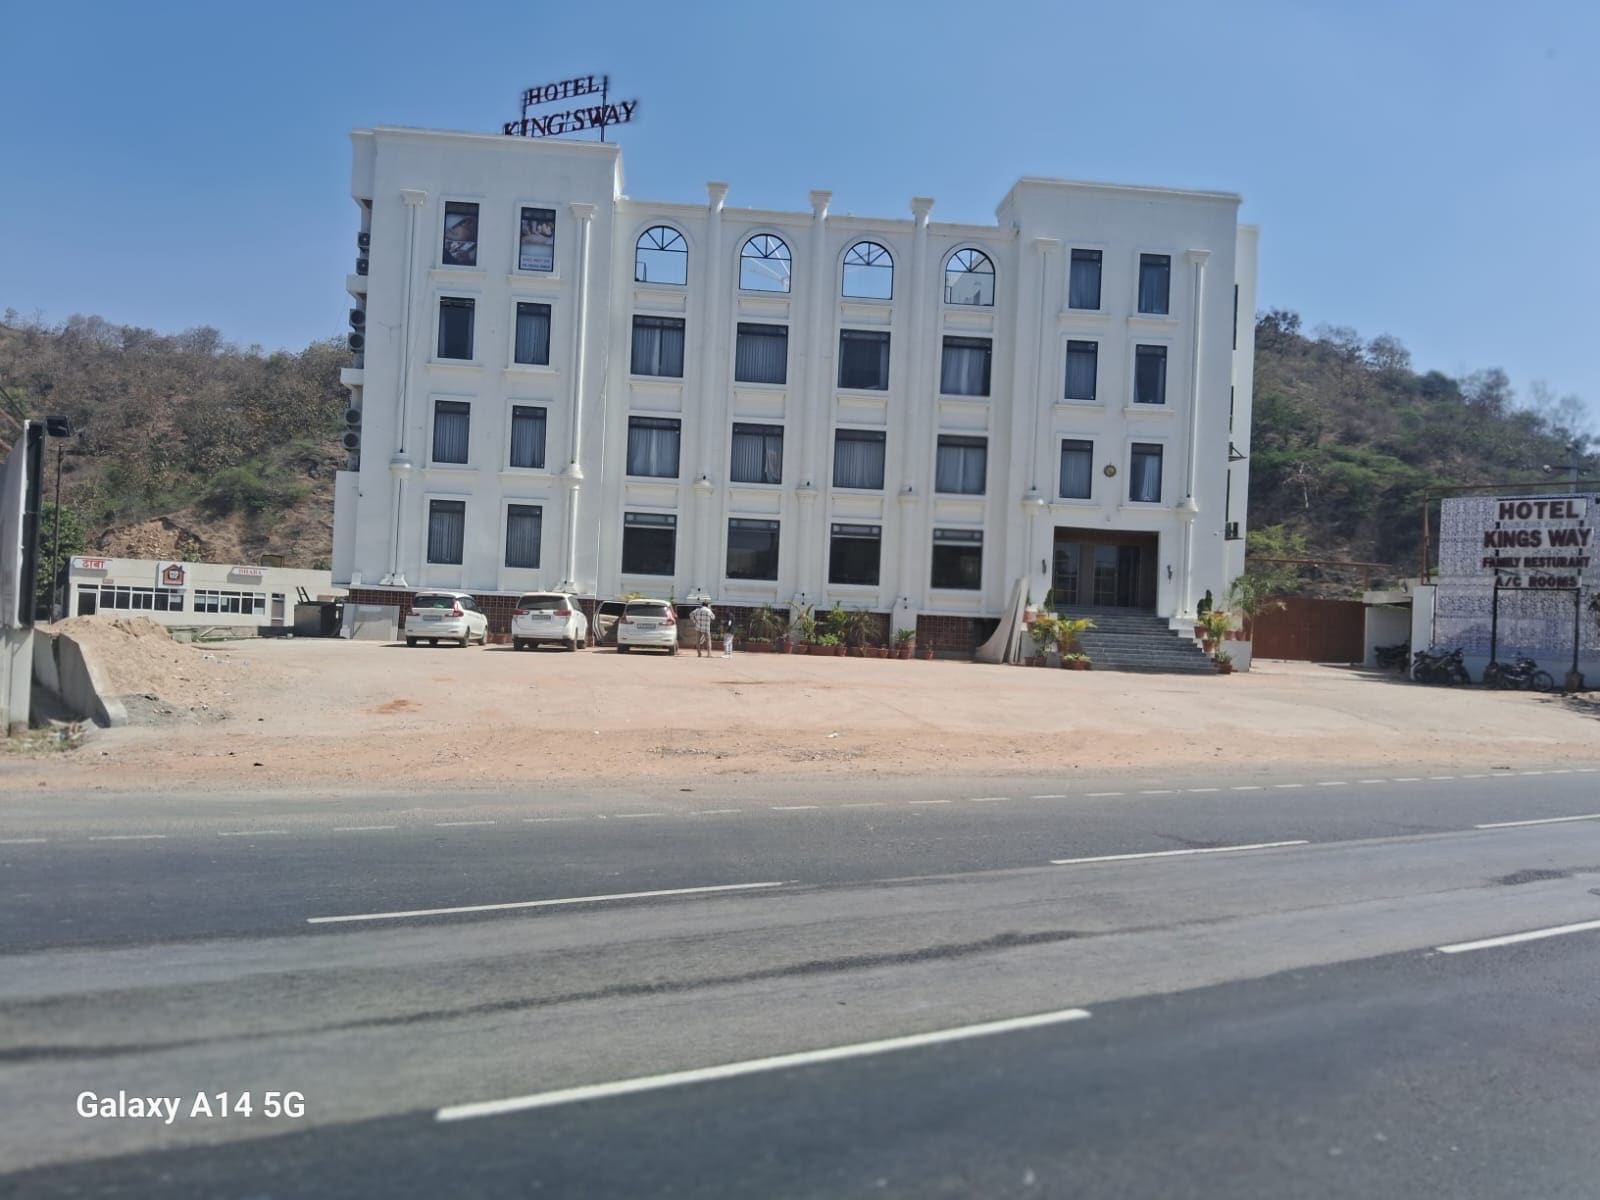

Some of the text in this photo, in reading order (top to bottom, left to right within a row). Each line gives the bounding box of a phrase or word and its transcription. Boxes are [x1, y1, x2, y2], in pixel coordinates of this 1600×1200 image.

[526, 75, 600, 105] HOTEL
[1499, 501, 1579, 520] HOTEL
[1484, 529, 1591, 548] KINGS WAY
[1483, 557, 1520, 568] FAMILY
[1496, 575, 1577, 587] A/C ROOMS
